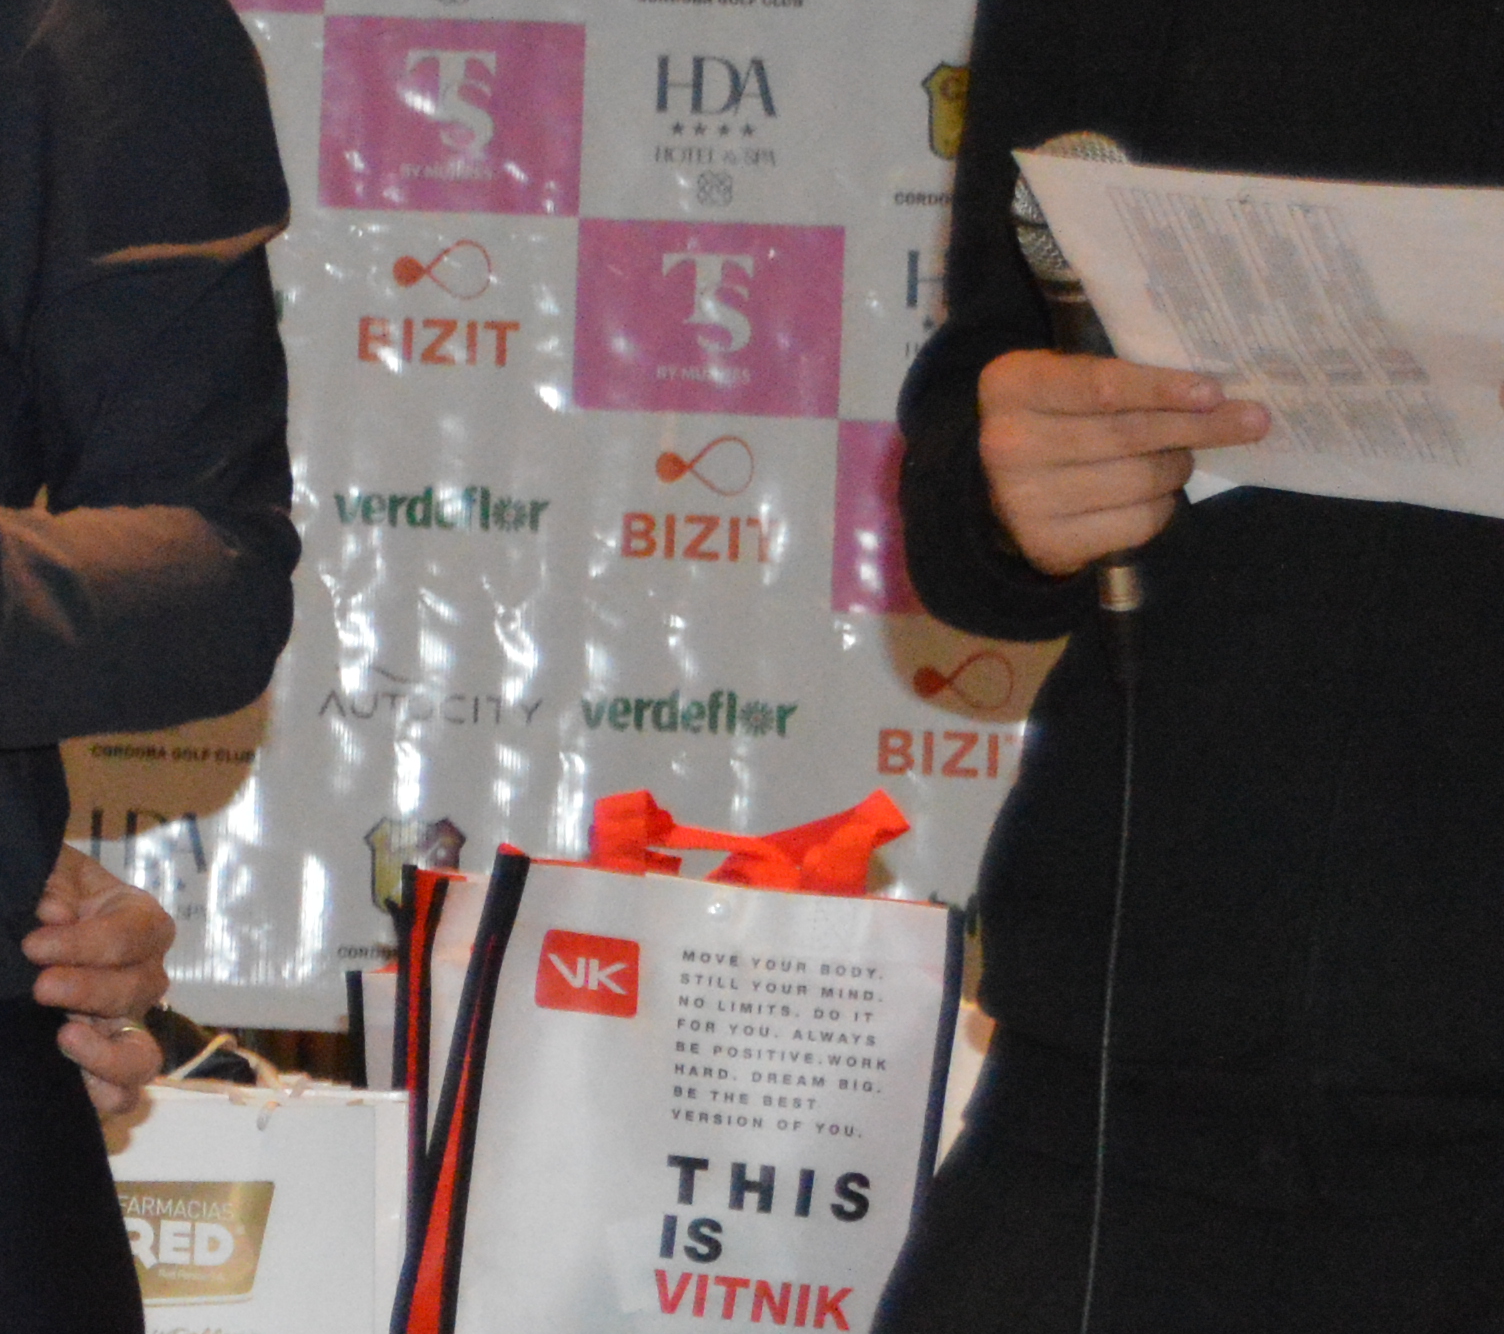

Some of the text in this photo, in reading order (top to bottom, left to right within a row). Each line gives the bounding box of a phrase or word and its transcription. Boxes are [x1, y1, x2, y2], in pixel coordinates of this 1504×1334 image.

[654, 53, 777, 119] HDA
[681, 949, 884, 981] MOVE YOUR BODY.
[679, 972, 883, 1003] STILL YOUR MIND.
[678, 995, 874, 1023] NO LIMITS. DO IT
[675, 1040, 700, 1055] BE
[676, 1017, 877, 1047] FOR YOU. ALWAYS
[673, 1063, 882, 1094] HARD. DREAM BIG.
[673, 1085, 817, 1111] BE THE BEST
[670, 1107, 863, 1139] VERSION OF YOU.
[667, 1154, 871, 1223] THIS
[659, 1214, 723, 1264] IS
[655, 1269, 854, 1332] VITNIK
